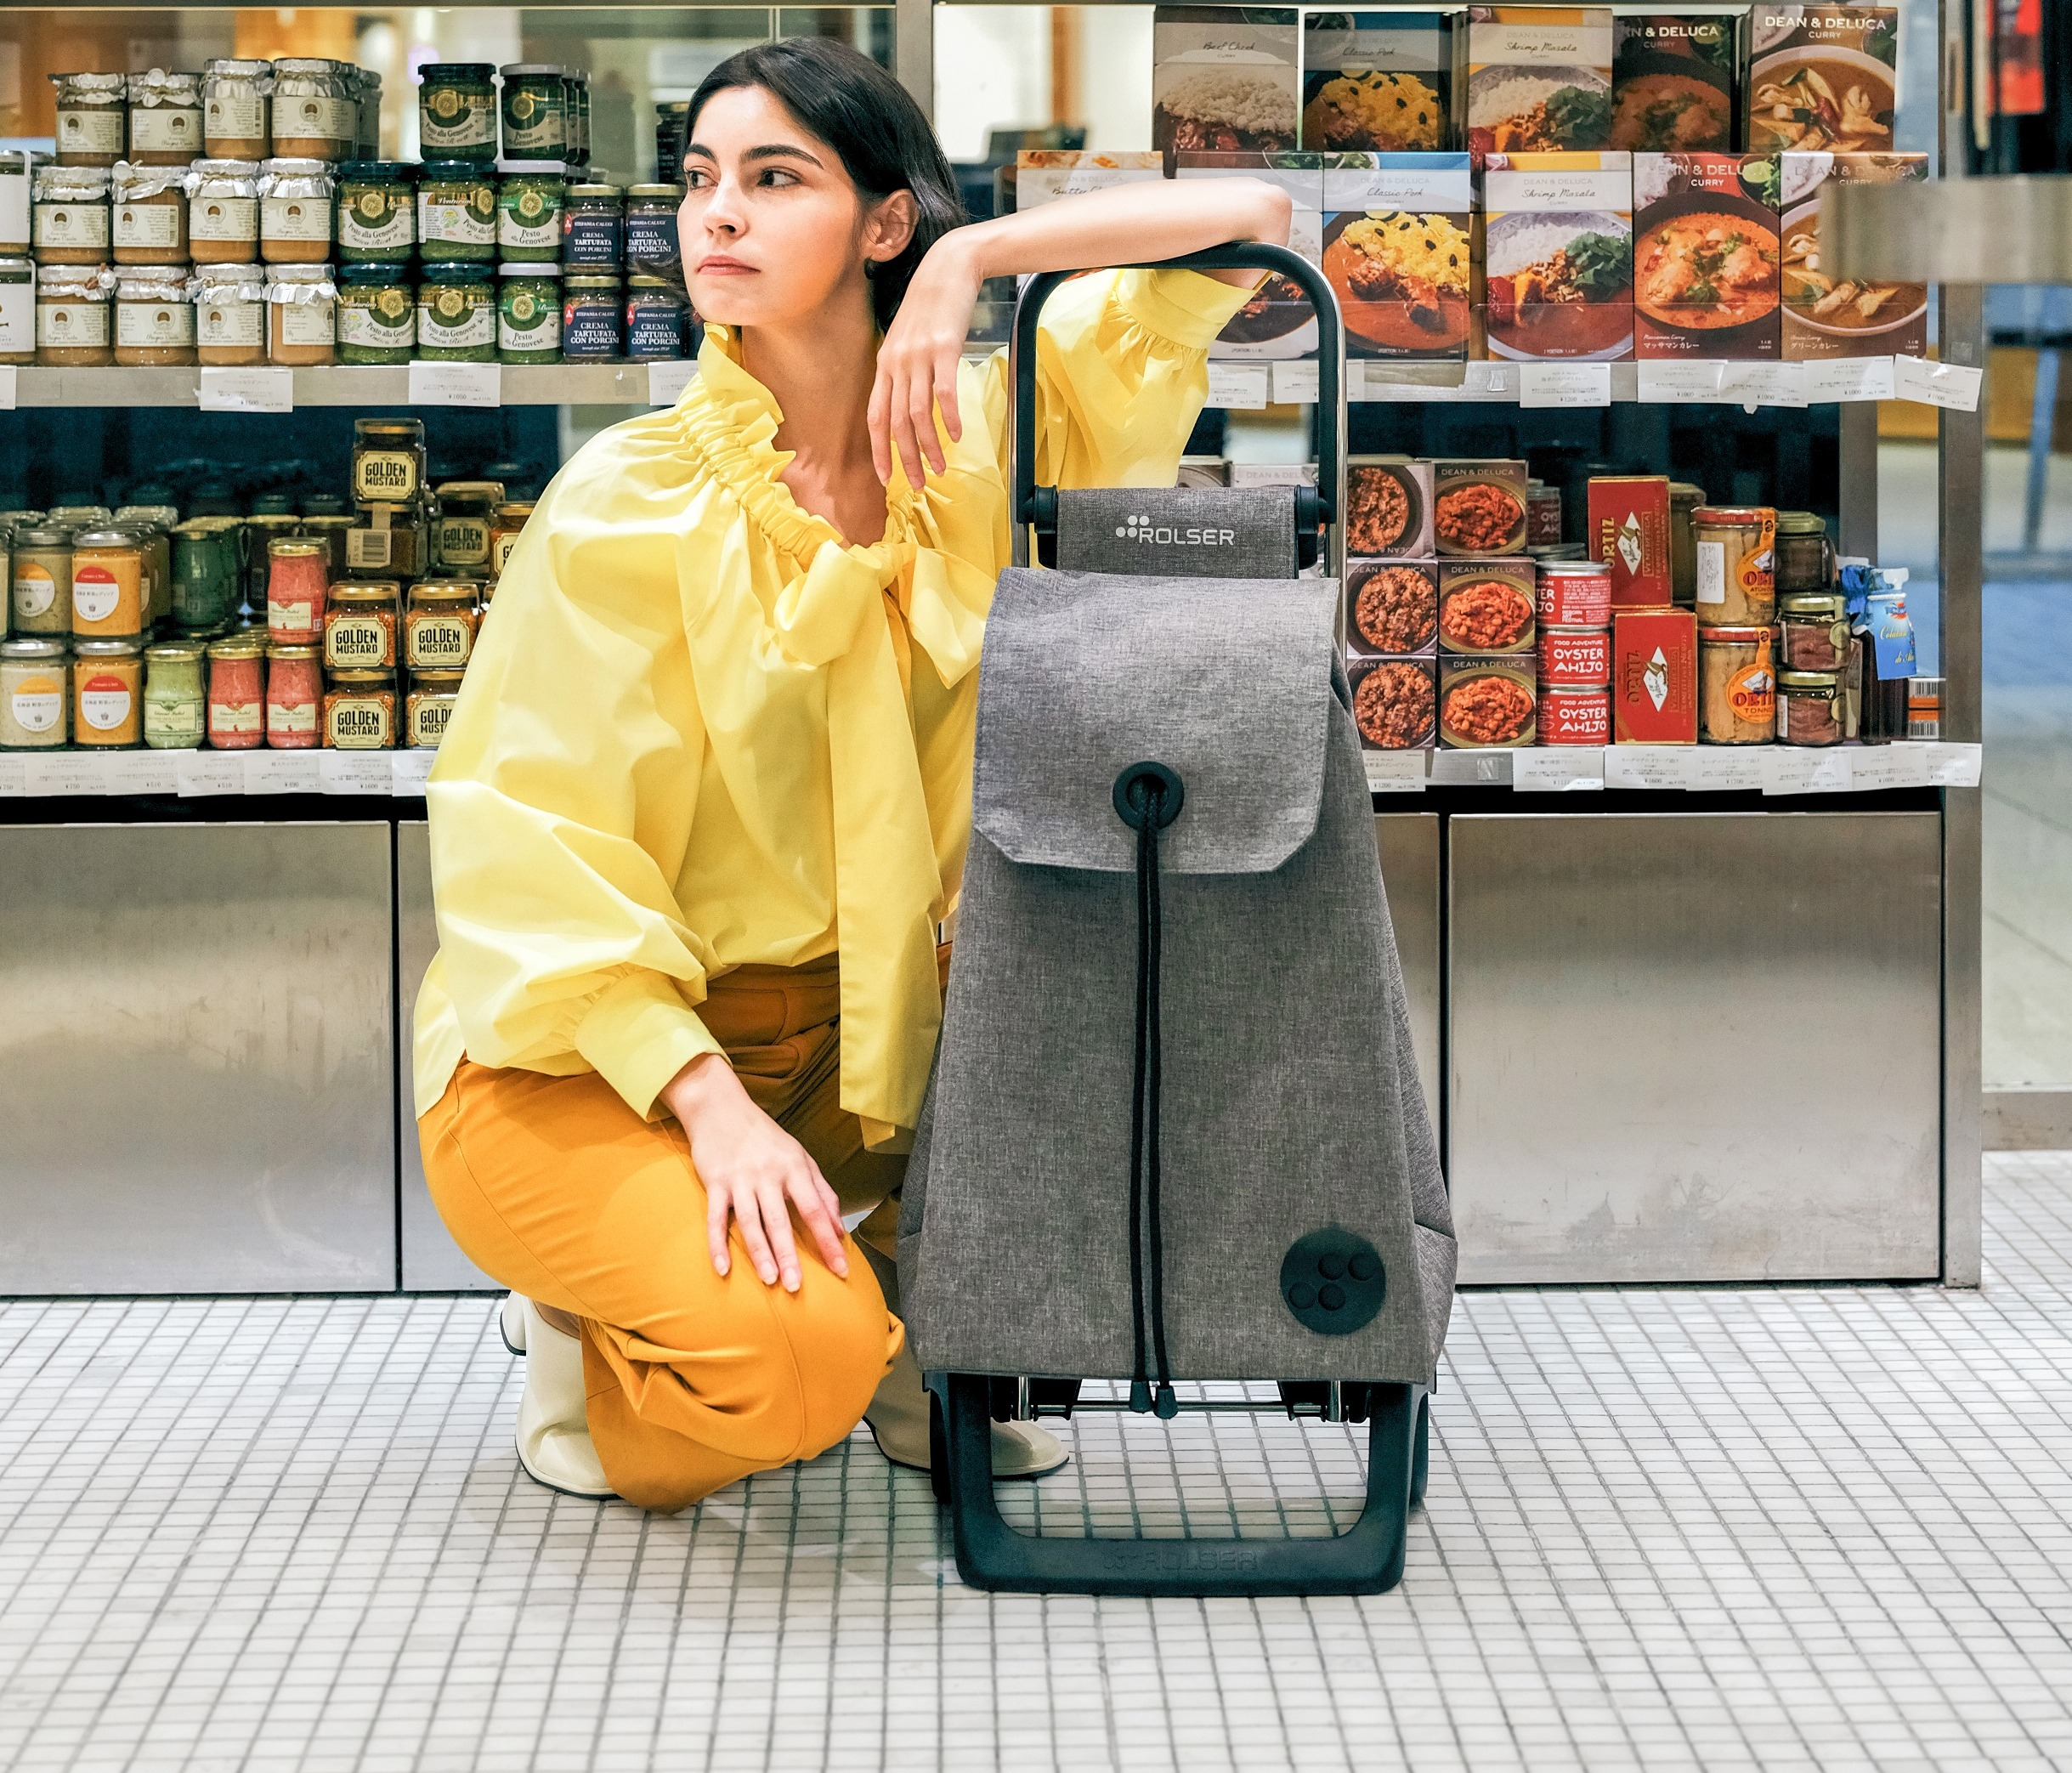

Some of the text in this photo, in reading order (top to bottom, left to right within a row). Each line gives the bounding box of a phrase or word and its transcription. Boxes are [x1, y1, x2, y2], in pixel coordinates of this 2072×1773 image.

[1765, 15, 1887, 31] DEAN & DELUCA
[1645, 26, 1719, 37] & DELUCA
[1808, 30, 1842, 39] CURRY
[1203, 42, 1227, 51] Beef
[1504, 42, 1577, 54] Shrimp Masala
[515, 131, 533, 141] Pesto
[1692, 165, 1702, 176] &
[1690, 178, 1724, 187] CURRY
[1367, 187, 1423, 197] Classic Pork
[1521, 188, 1596, 201] Shrimp Masala
[372, 223, 400, 239] Genovese
[464, 218, 478, 233] Pesto
[521, 229, 541, 238] Pesto
[631, 230, 659, 239] CREMA
[519, 234, 552, 246] Genovese
[574, 238, 613, 246] TARTUFATA
[628, 238, 668, 246] TARTUFATA
[638, 245, 671, 253] PORCINI
[366, 322, 393, 337] Pesto alla
[427, 321, 439, 337] Pesto
[450, 323, 477, 337] Genovese
[580, 322, 609, 331] CREMA
[514, 332, 533, 341] Pesto
[573, 330, 617, 338] TARTUFATA
[512, 337, 544, 348] Genovese
[365, 462, 406, 477] GOLDEN
[1246, 471, 1273, 479] DEAN
[365, 476, 407, 487] MUSTARD
[444, 527, 483, 541] GOLDEN
[1139, 528, 1235, 546] ROLSER
[444, 540, 483, 552] MUSTARD
[1536, 588, 1555, 600] TER
[336, 630, 378, 644] GOLDEN
[418, 629, 461, 643] GOLDEN
[336, 643, 378, 654] MUSTARD
[418, 643, 461, 654] MUSTARD
[1553, 648, 1605, 660] OYSTER
[1554, 661, 1604, 673] AHIJO
[1627, 649, 1641, 705] ORTIZ
[1732, 691, 1773, 707] ORTI
[337, 711, 380, 726] GOLDEN
[1559, 707, 1607, 720] OYSTER
[337, 724, 380, 736] MUSTARD
[420, 723, 447, 734] MUST
[1560, 720, 1607, 734] AHIJO
